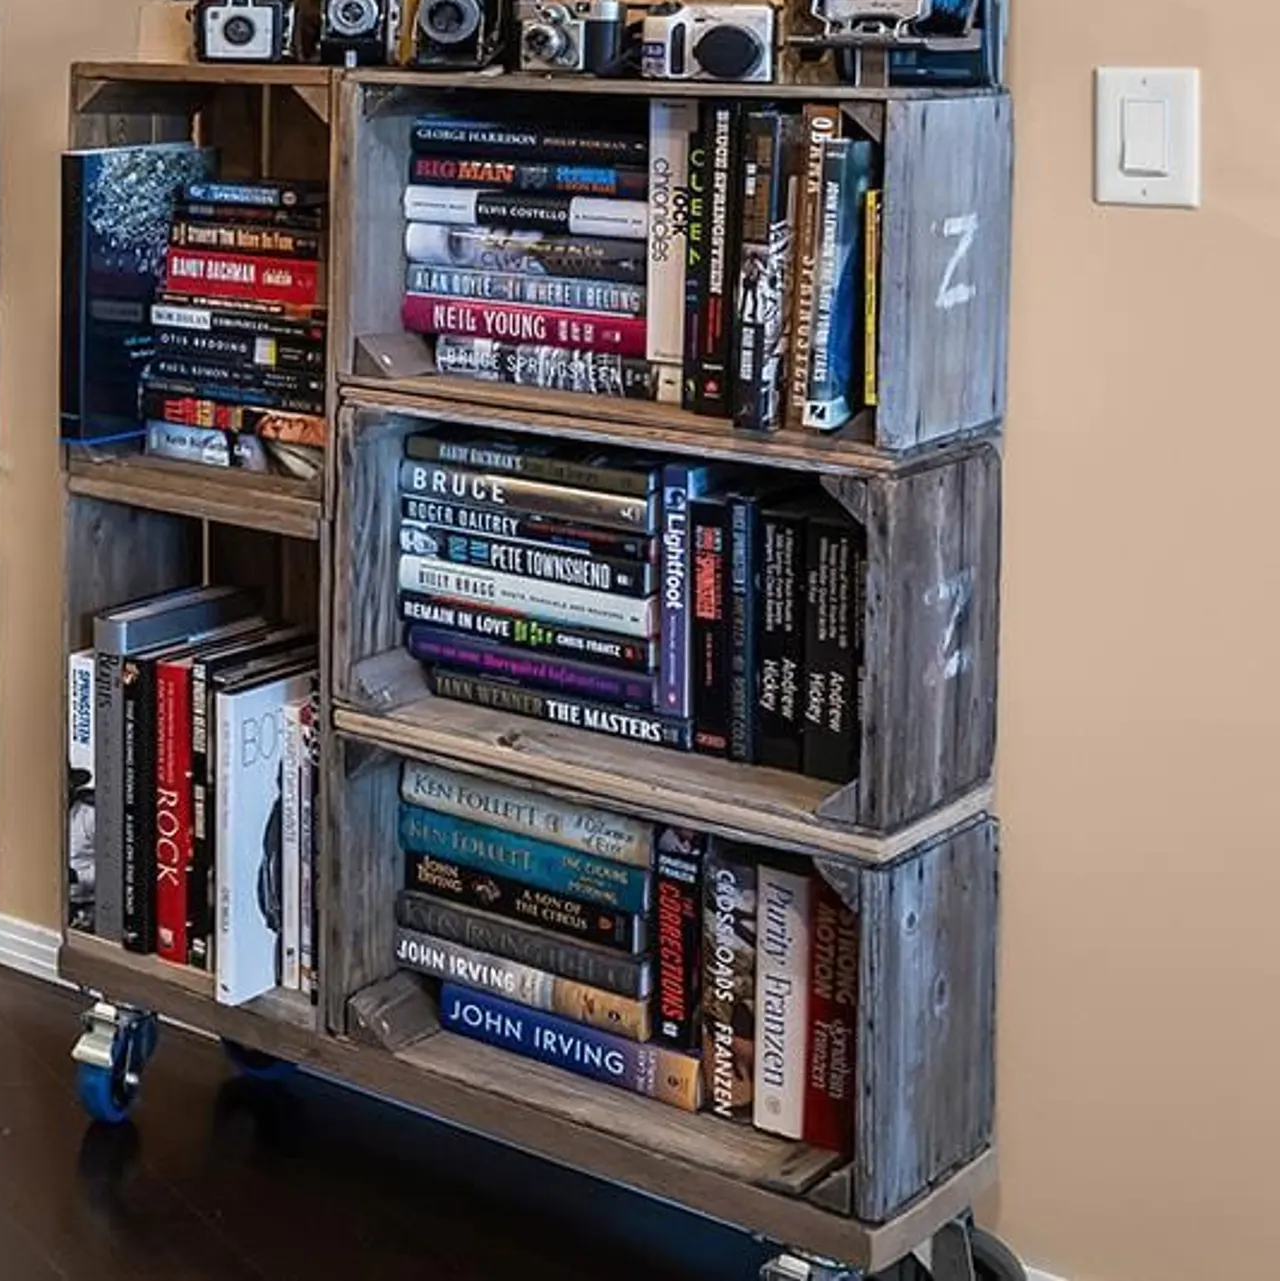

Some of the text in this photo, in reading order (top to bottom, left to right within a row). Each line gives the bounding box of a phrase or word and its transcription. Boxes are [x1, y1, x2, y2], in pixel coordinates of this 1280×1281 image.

[417, 127, 537, 146] GEORGE HARRISON
[478, 204, 507, 217] ELVIS
[510, 206, 567, 220] COSTELLO
[651, 157, 671, 263] chronicles
[672, 186, 689, 236] rock
[824, 181, 840, 212] JOHN
[709, 172, 728, 295] SPRINGSTEEN
[821, 214, 838, 258] LENNON
[415, 271, 640, 310] ALAN DOYLE WHERE I BELONG
[160, 333, 248, 353] OTIS REDDING
[433, 305, 477, 330] NEIL
[483, 310, 547, 340] YOUNG
[446, 347, 621, 384] BRUCE SPRINGSTEEN
[813, 343, 829, 382] YEARS
[412, 466, 506, 504] BRUCE
[407, 499, 454, 525] ROGER
[458, 510, 521, 537] DALTREY
[417, 570, 495, 597] BILLY BRAGG
[491, 543, 523, 572] PETE
[526, 550, 611, 589] TOWNSHEND
[663, 513, 687, 609] Lightfoot
[403, 601, 511, 637] REMAIN IN LOVE
[555, 633, 622, 658] CHRIS FRANTZ
[78, 669, 91, 745] SPRINGSTEEN
[760, 659, 778, 711] Hickey
[781, 657, 797, 721] Andrew
[805, 673, 825, 724] Hickey
[828, 671, 845, 732] Andrew
[546, 699, 582, 725] THE
[584, 709, 662, 742] MASTERS
[413, 773, 538, 825] KEN FOLLETT
[157, 787, 180, 887] ROCK
[408, 819, 534, 870] KEN FOLLETT
[417, 855, 460, 879] JOHN
[417, 870, 464, 894] IRVING
[515, 899, 589, 931] THE CIRCUS
[521, 889, 582, 915] A SON OF
[397, 939, 515, 994] JOHN IRVING
[658, 881, 685, 1021] CORRECTIONS
[814, 902, 837, 1000] MOTION
[835, 908, 856, 1006] STRONG
[713, 869, 736, 1117] CROSSROADS FRANZEN
[762, 881, 793, 1088] Purity Franzen
[449, 1000, 523, 1041] JOHN
[534, 1026, 625, 1075] IRVING
[811, 1019, 830, 1089] Franzen
[828, 1018, 851, 1099] Jonathan
